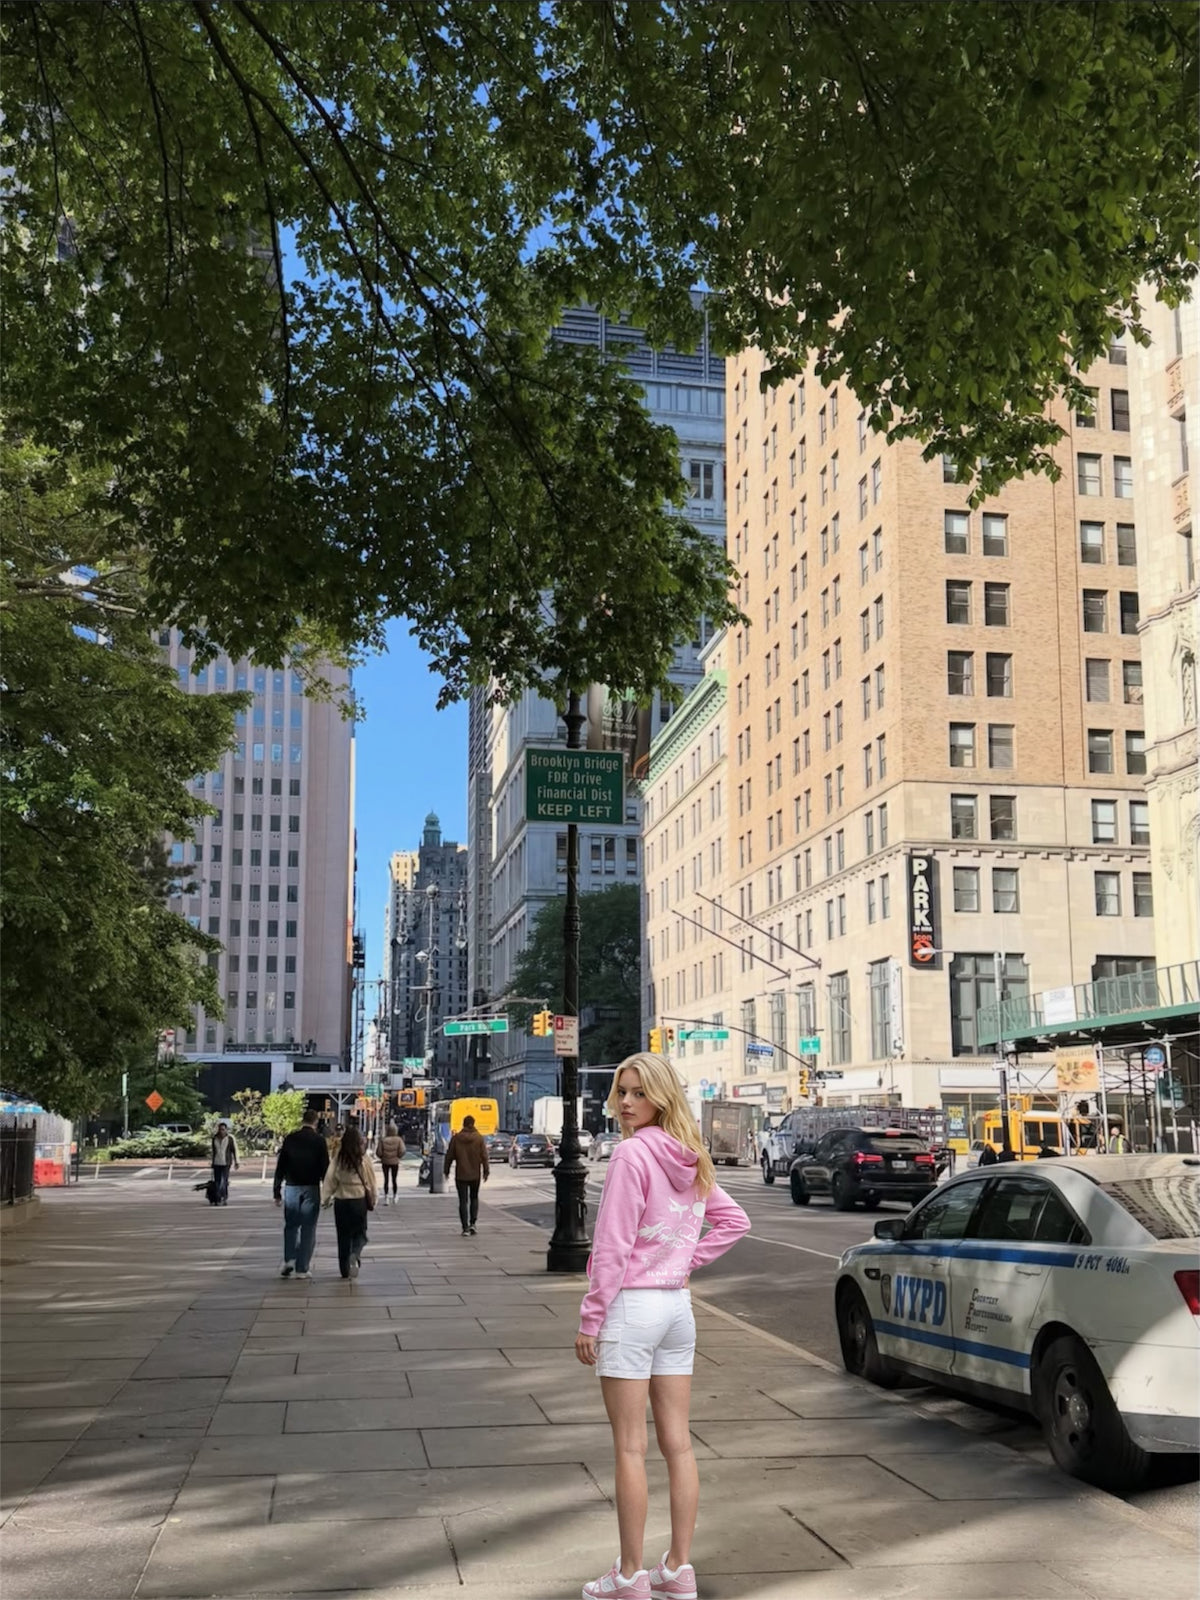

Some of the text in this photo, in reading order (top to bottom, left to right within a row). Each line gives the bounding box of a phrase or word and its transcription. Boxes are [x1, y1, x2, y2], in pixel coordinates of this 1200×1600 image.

[530, 754, 619, 773] Brooklyn Bridge
[548, 771, 602, 785] FDR Drive
[537, 786, 612, 802] Financial Dist
[537, 803, 612, 818] KEEP LEFT
[912, 858, 931, 926] PARK
[459, 1023, 476, 1032] Park
[1077, 1254, 1084, 1269] 9
[1084, 1254, 1103, 1270] PCT
[894, 1275, 947, 1327] NYPD
